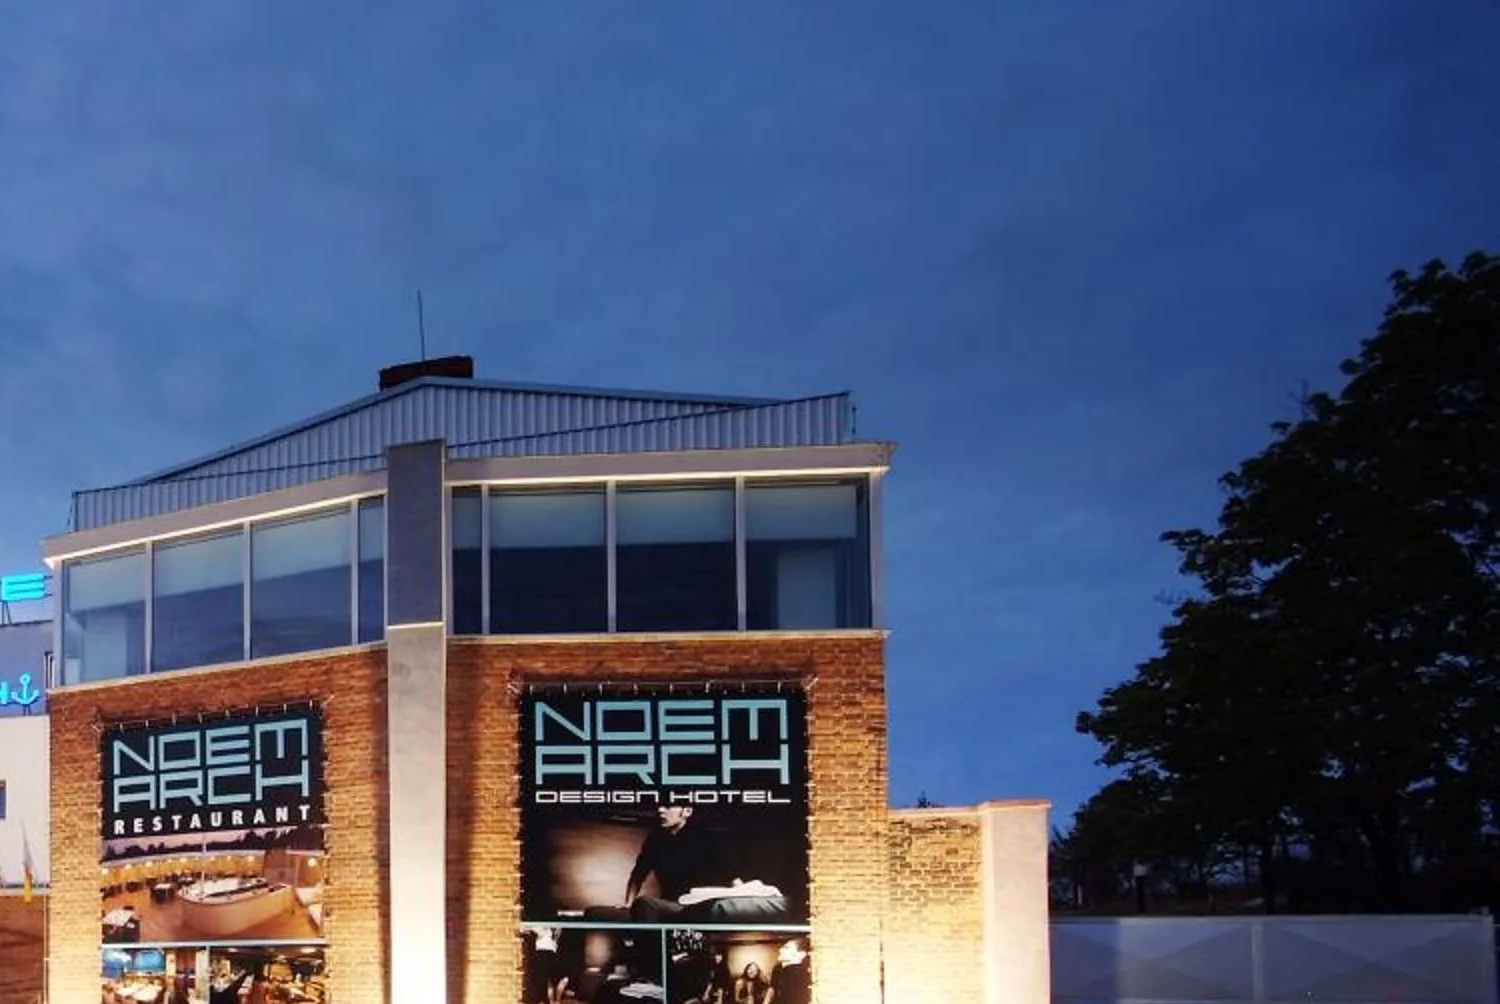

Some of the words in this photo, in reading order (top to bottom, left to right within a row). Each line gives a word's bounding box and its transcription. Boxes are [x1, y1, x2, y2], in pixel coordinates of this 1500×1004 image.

[535, 700, 788, 741] NOEM
[114, 719, 308, 775] NOEM
[535, 744, 790, 785] ARCH
[114, 760, 308, 813] ARCH
[669, 791, 791, 804] HOTEL
[115, 805, 310, 834] RESTAURANT
